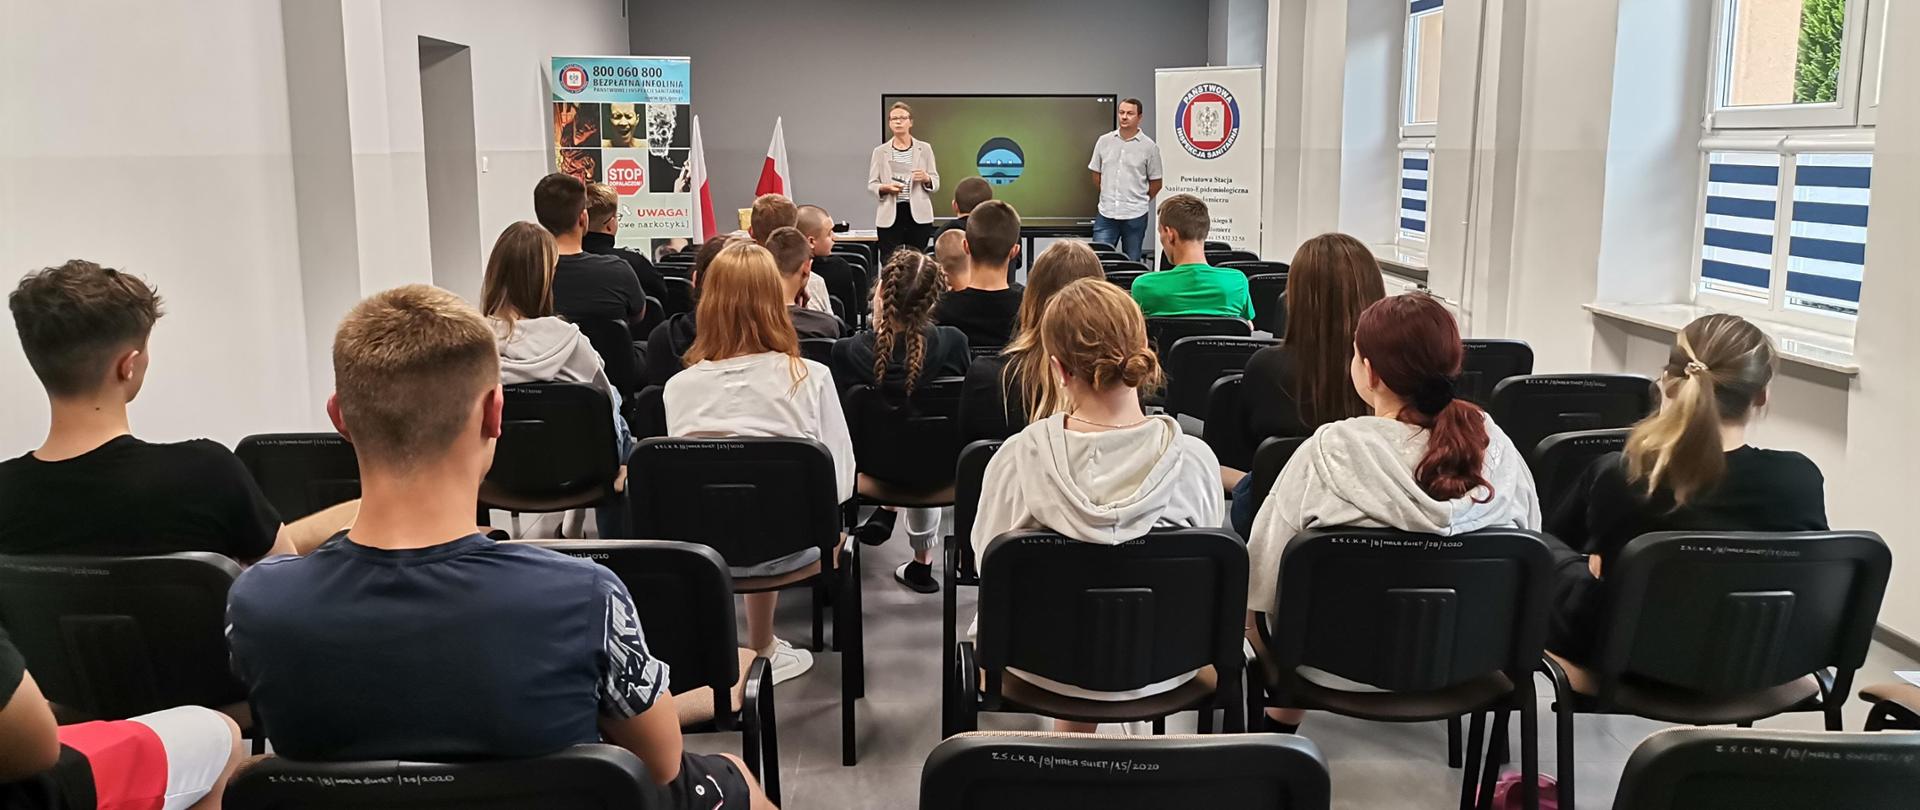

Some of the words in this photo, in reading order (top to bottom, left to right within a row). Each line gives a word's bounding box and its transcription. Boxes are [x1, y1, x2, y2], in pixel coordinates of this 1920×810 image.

[593, 66, 614, 77] 800
[617, 67, 638, 77] 060
[641, 68, 662, 77] 800
[593, 79, 640, 87] BEZPŁATNA
[642, 80, 684, 88] INFOLINIA
[1183, 84, 1232, 103] PAŃSTWOWA
[1177, 127, 1206, 158] INSPEKCJA
[1207, 127, 1239, 158] SANITARNA
[609, 168, 642, 181] STOP
[1165, 185, 1249, 194] Sanitarno-Epidemiologiczna
[637, 209, 688, 217] UWAGA!
